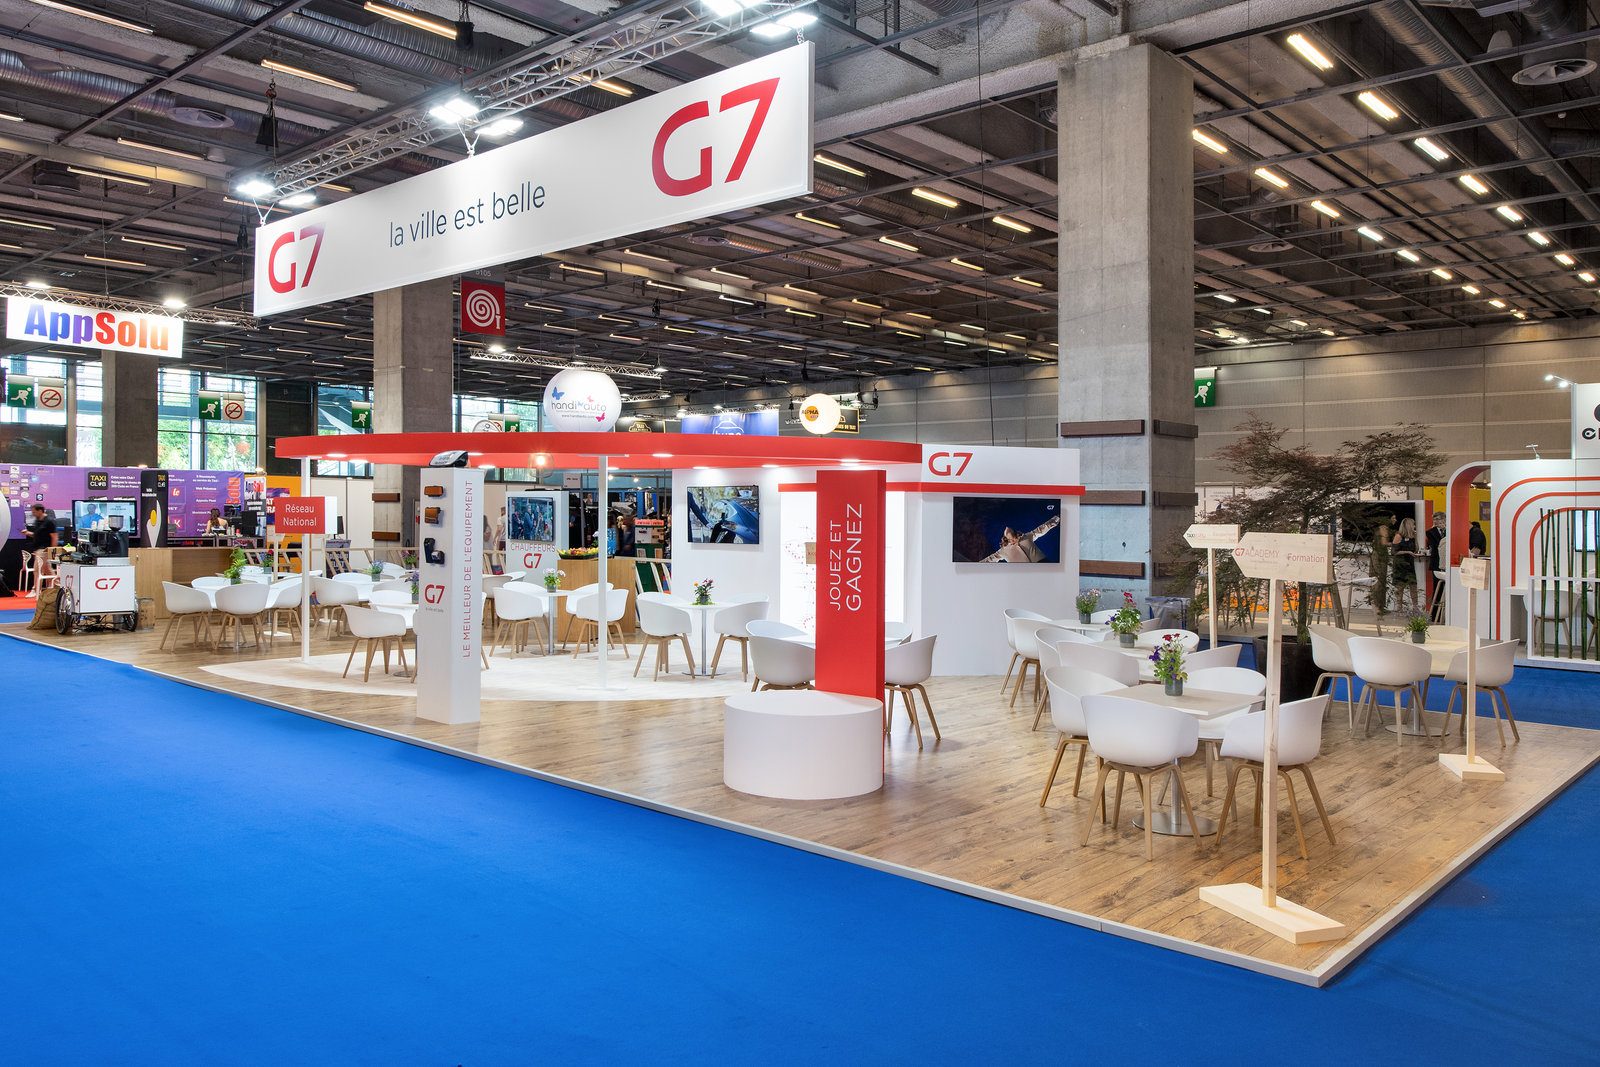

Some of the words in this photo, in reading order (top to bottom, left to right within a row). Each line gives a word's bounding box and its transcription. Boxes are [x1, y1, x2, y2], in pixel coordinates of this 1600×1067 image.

[652, 77, 780, 197] G7
[389, 221, 404, 248] la
[410, 209, 447, 242] ville
[454, 198, 484, 230] est
[492, 181, 546, 220] belle
[268, 221, 326, 294] G7
[24, 303, 169, 351] AppSolu
[928, 451, 973, 477] G7
[285, 503, 315, 513] Réseau
[464, 480, 473, 557] L'EQUIPEMENT
[283, 517, 317, 527] National
[830, 520, 842, 542] ET
[510, 543, 556, 552] CHAUFFEURS
[846, 503, 863, 611] GAGNEZ
[1287, 552, 1326, 564] Formation
[523, 553, 542, 569] G7
[94, 577, 121, 590] G7
[464, 566, 472, 580] DE
[830, 550, 842, 611] JOUEZ
[424, 584, 445, 604] G7
[463, 585, 472, 641] MEILLEUR
[463, 643, 470, 658] LE
